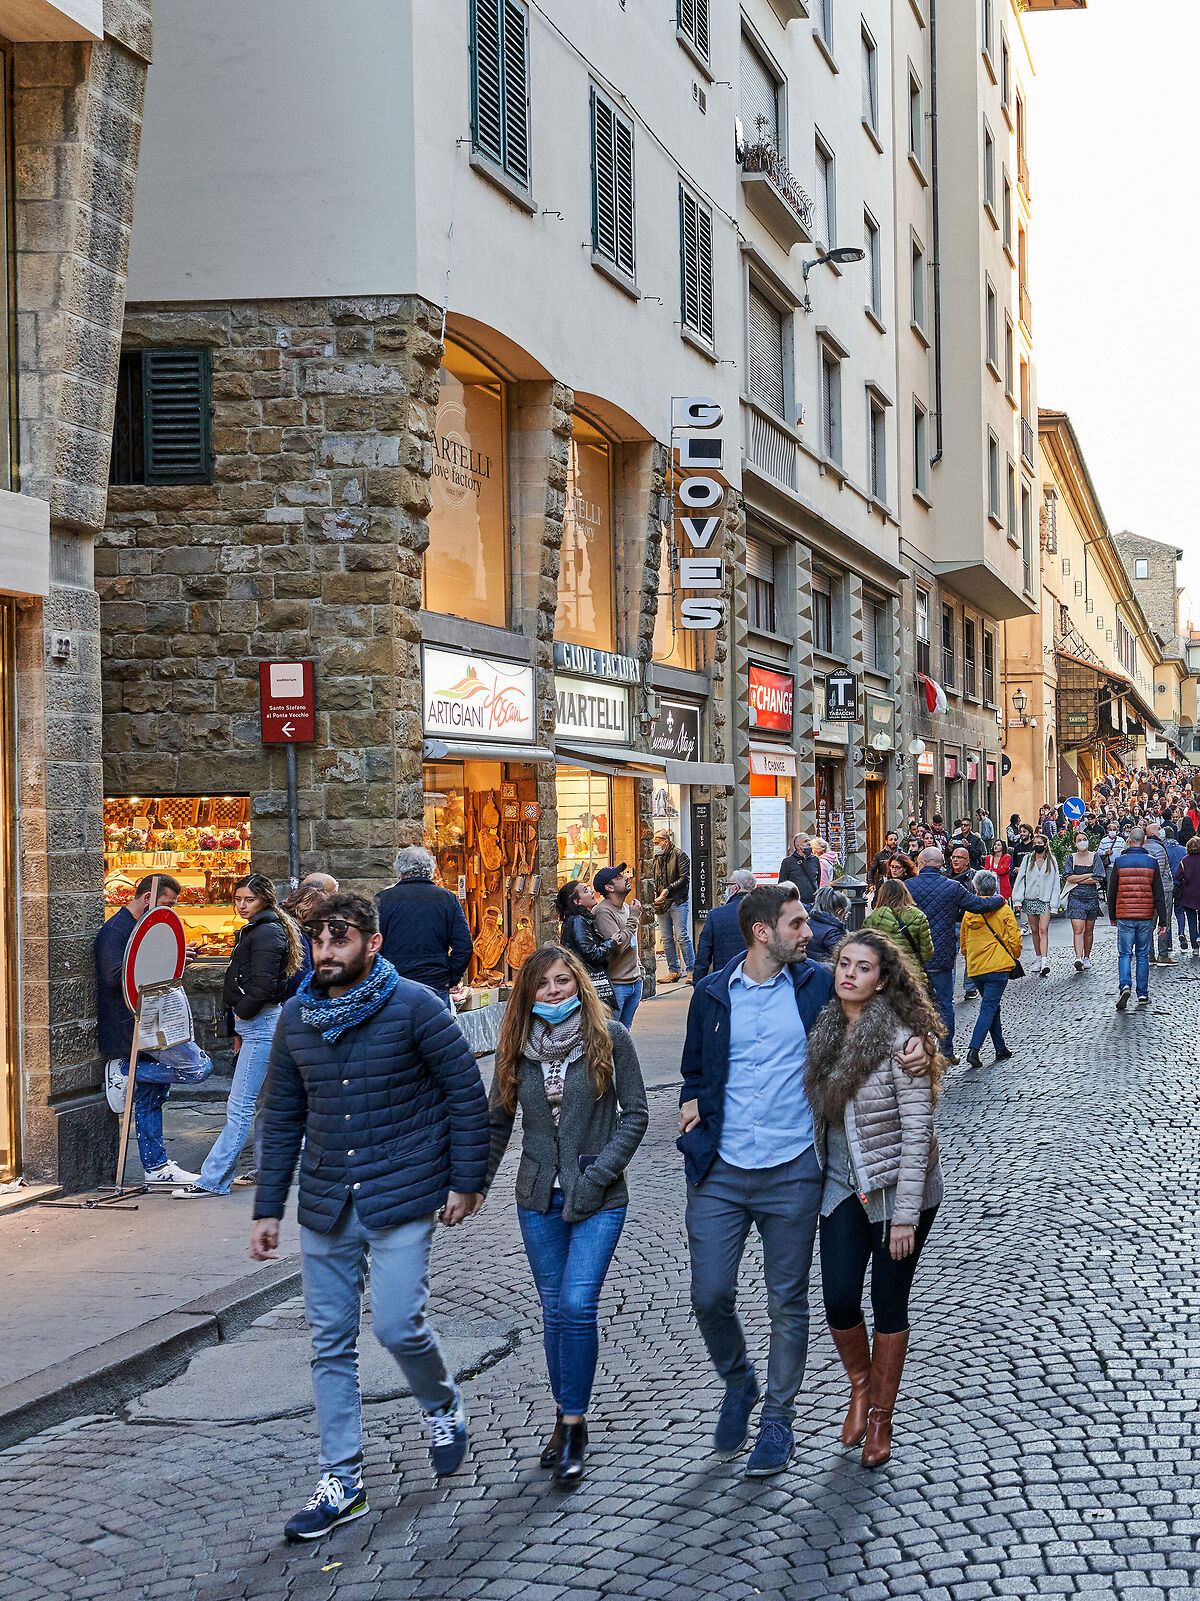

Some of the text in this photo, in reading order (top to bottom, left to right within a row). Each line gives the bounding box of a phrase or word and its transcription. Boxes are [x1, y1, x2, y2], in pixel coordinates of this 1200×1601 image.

[679, 396, 725, 630] GLOVES
[57, 638, 70, 655] 22
[563, 643, 641, 683] GLOVE FACTORY
[757, 685, 793, 716] CHANGE
[830, 678, 853, 705] T
[428, 700, 484, 728] ARTIGIANI
[555, 691, 625, 731] MARTELLI
[767, 760, 785, 772] CHANGE
